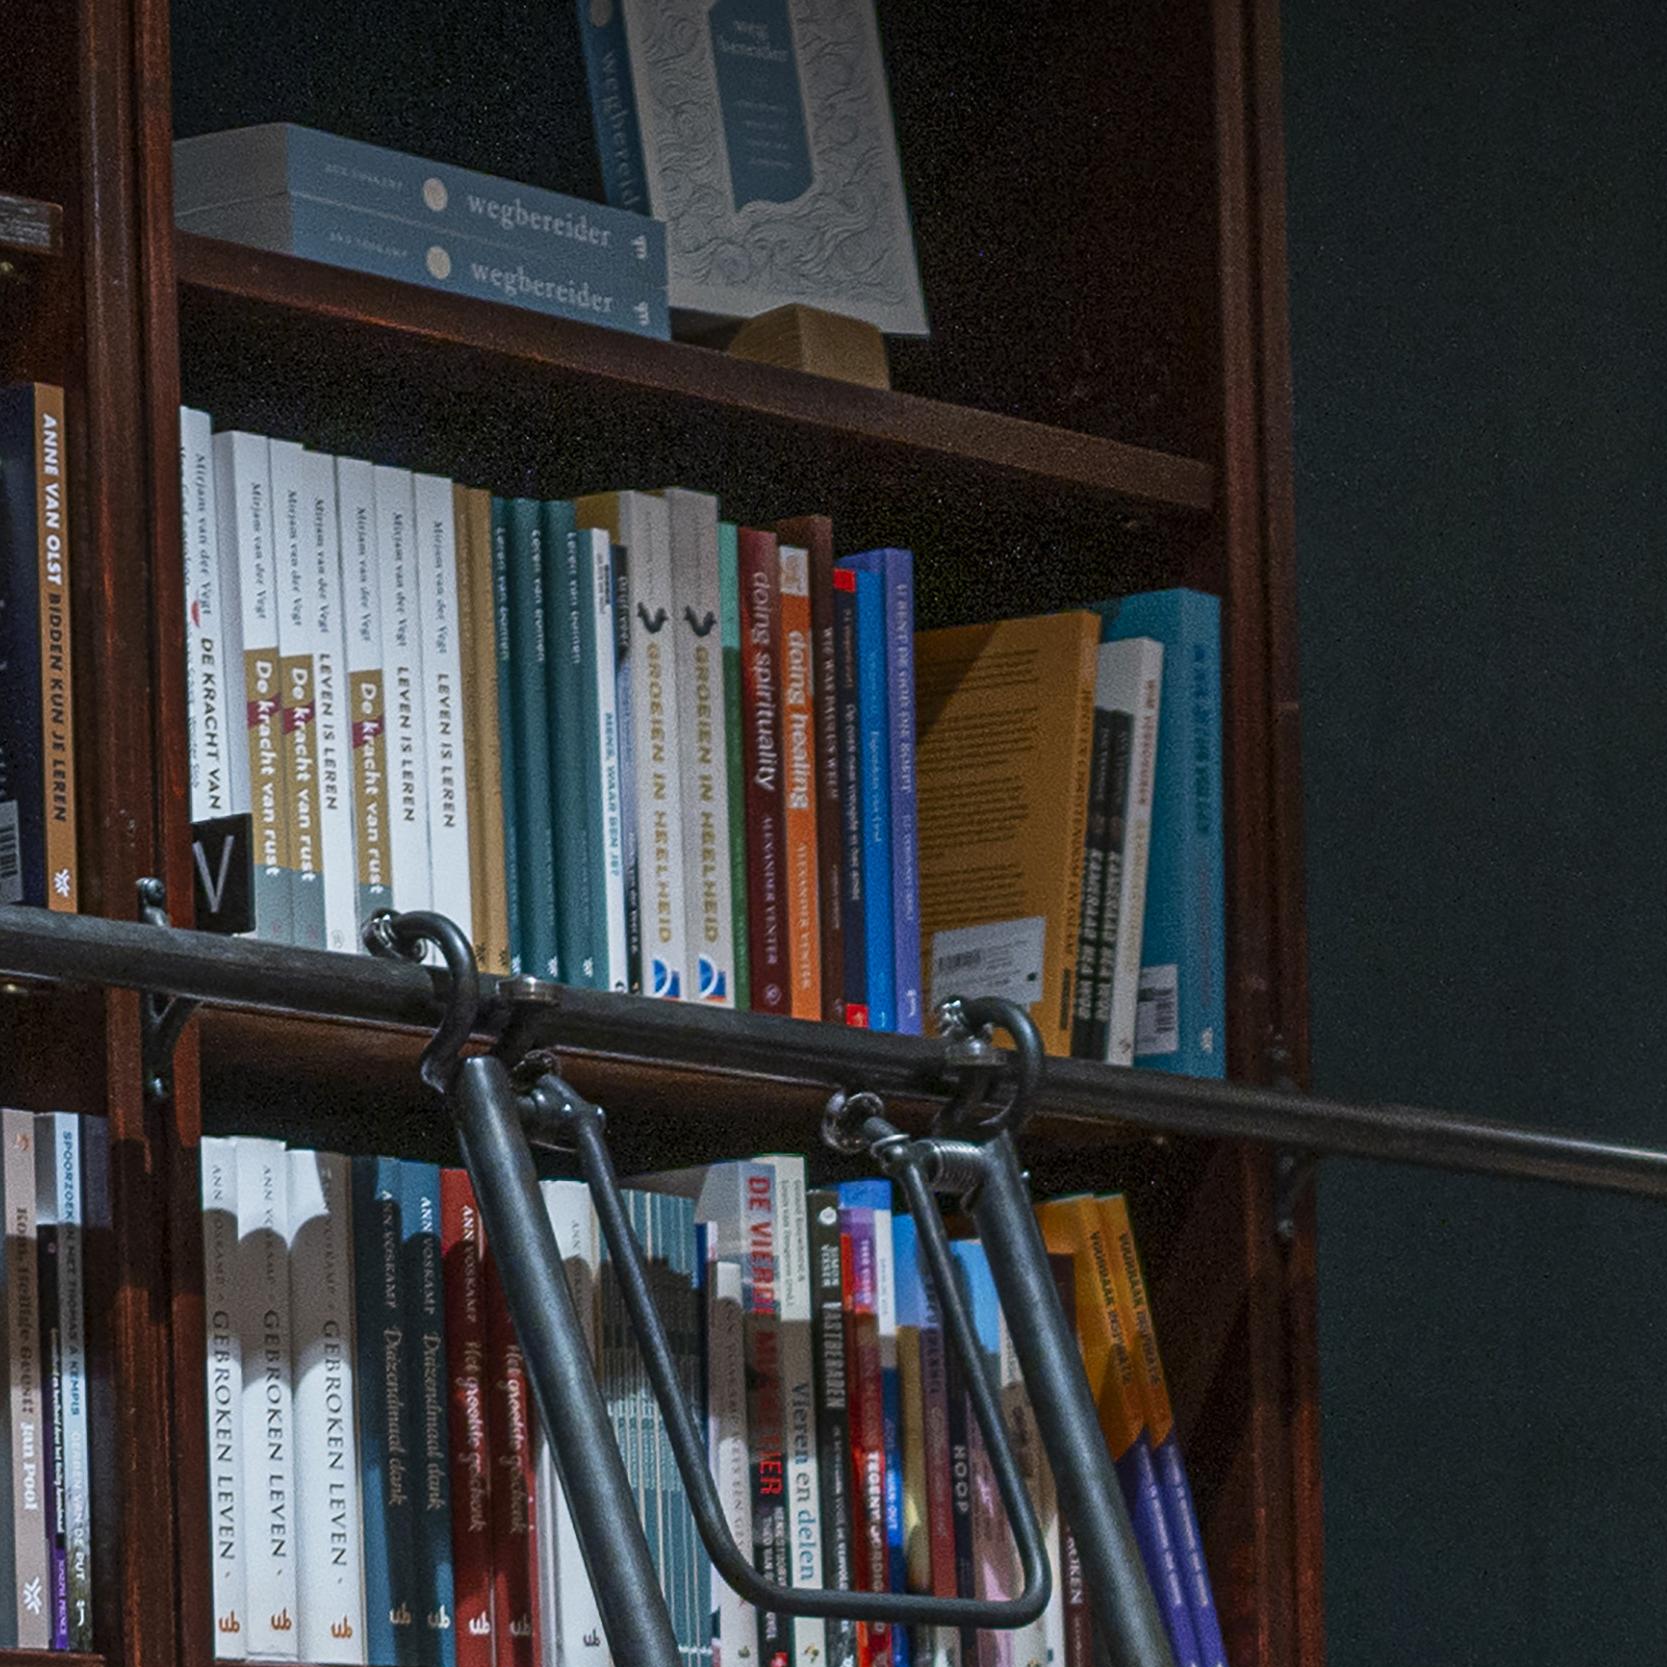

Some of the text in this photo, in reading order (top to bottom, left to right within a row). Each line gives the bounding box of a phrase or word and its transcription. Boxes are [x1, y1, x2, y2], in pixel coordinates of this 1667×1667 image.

[468, 195, 610, 246] wegbereider
[472, 263, 613, 313] wegbereider
[43, 414, 58, 475] ANNE
[44, 483, 59, 528] VAN
[198, 519, 206, 544] van
[46, 535, 61, 584] OLST
[749, 572, 776, 644] doing
[200, 638, 215, 667] DE
[50, 679, 64, 722] KUN
[201, 673, 218, 758] KRACHT
[320, 654, 337, 810] LEVEN IS LEREN
[694, 644, 712, 763] GROEIEN
[751, 652, 779, 791] spirituality
[784, 630, 813, 809] doing healing
[51, 730, 64, 752] JE
[254, 661, 279, 875] De kracht van rust
[52, 760, 66, 821] LEREN
[207, 768, 221, 811] VAN
[291, 668, 317, 881] De kracht van rust
[361, 683, 383, 893] De kracht van rust
[700, 774, 714, 801] IN
[193, 835, 235, 912] V
[766, 906, 778, 964] VENTER
[461, 1205, 475, 1241] ANN
[419, 1197, 446, 1511] ANN VOSKAMP Duizendmaal dank
[69, 1359, 81, 1415] KEMPIS
[20, 1422, 37, 1511] Jan Pool
[263, 1310, 287, 1558] GEBROKEN LEVEN
[321, 1320, 347, 1566] GEBROKEN LEVEN
[387, 1462, 408, 1506] dank
[789, 1382, 817, 1581] Vieren en delen
[953, 1444, 969, 1513] HOOP
